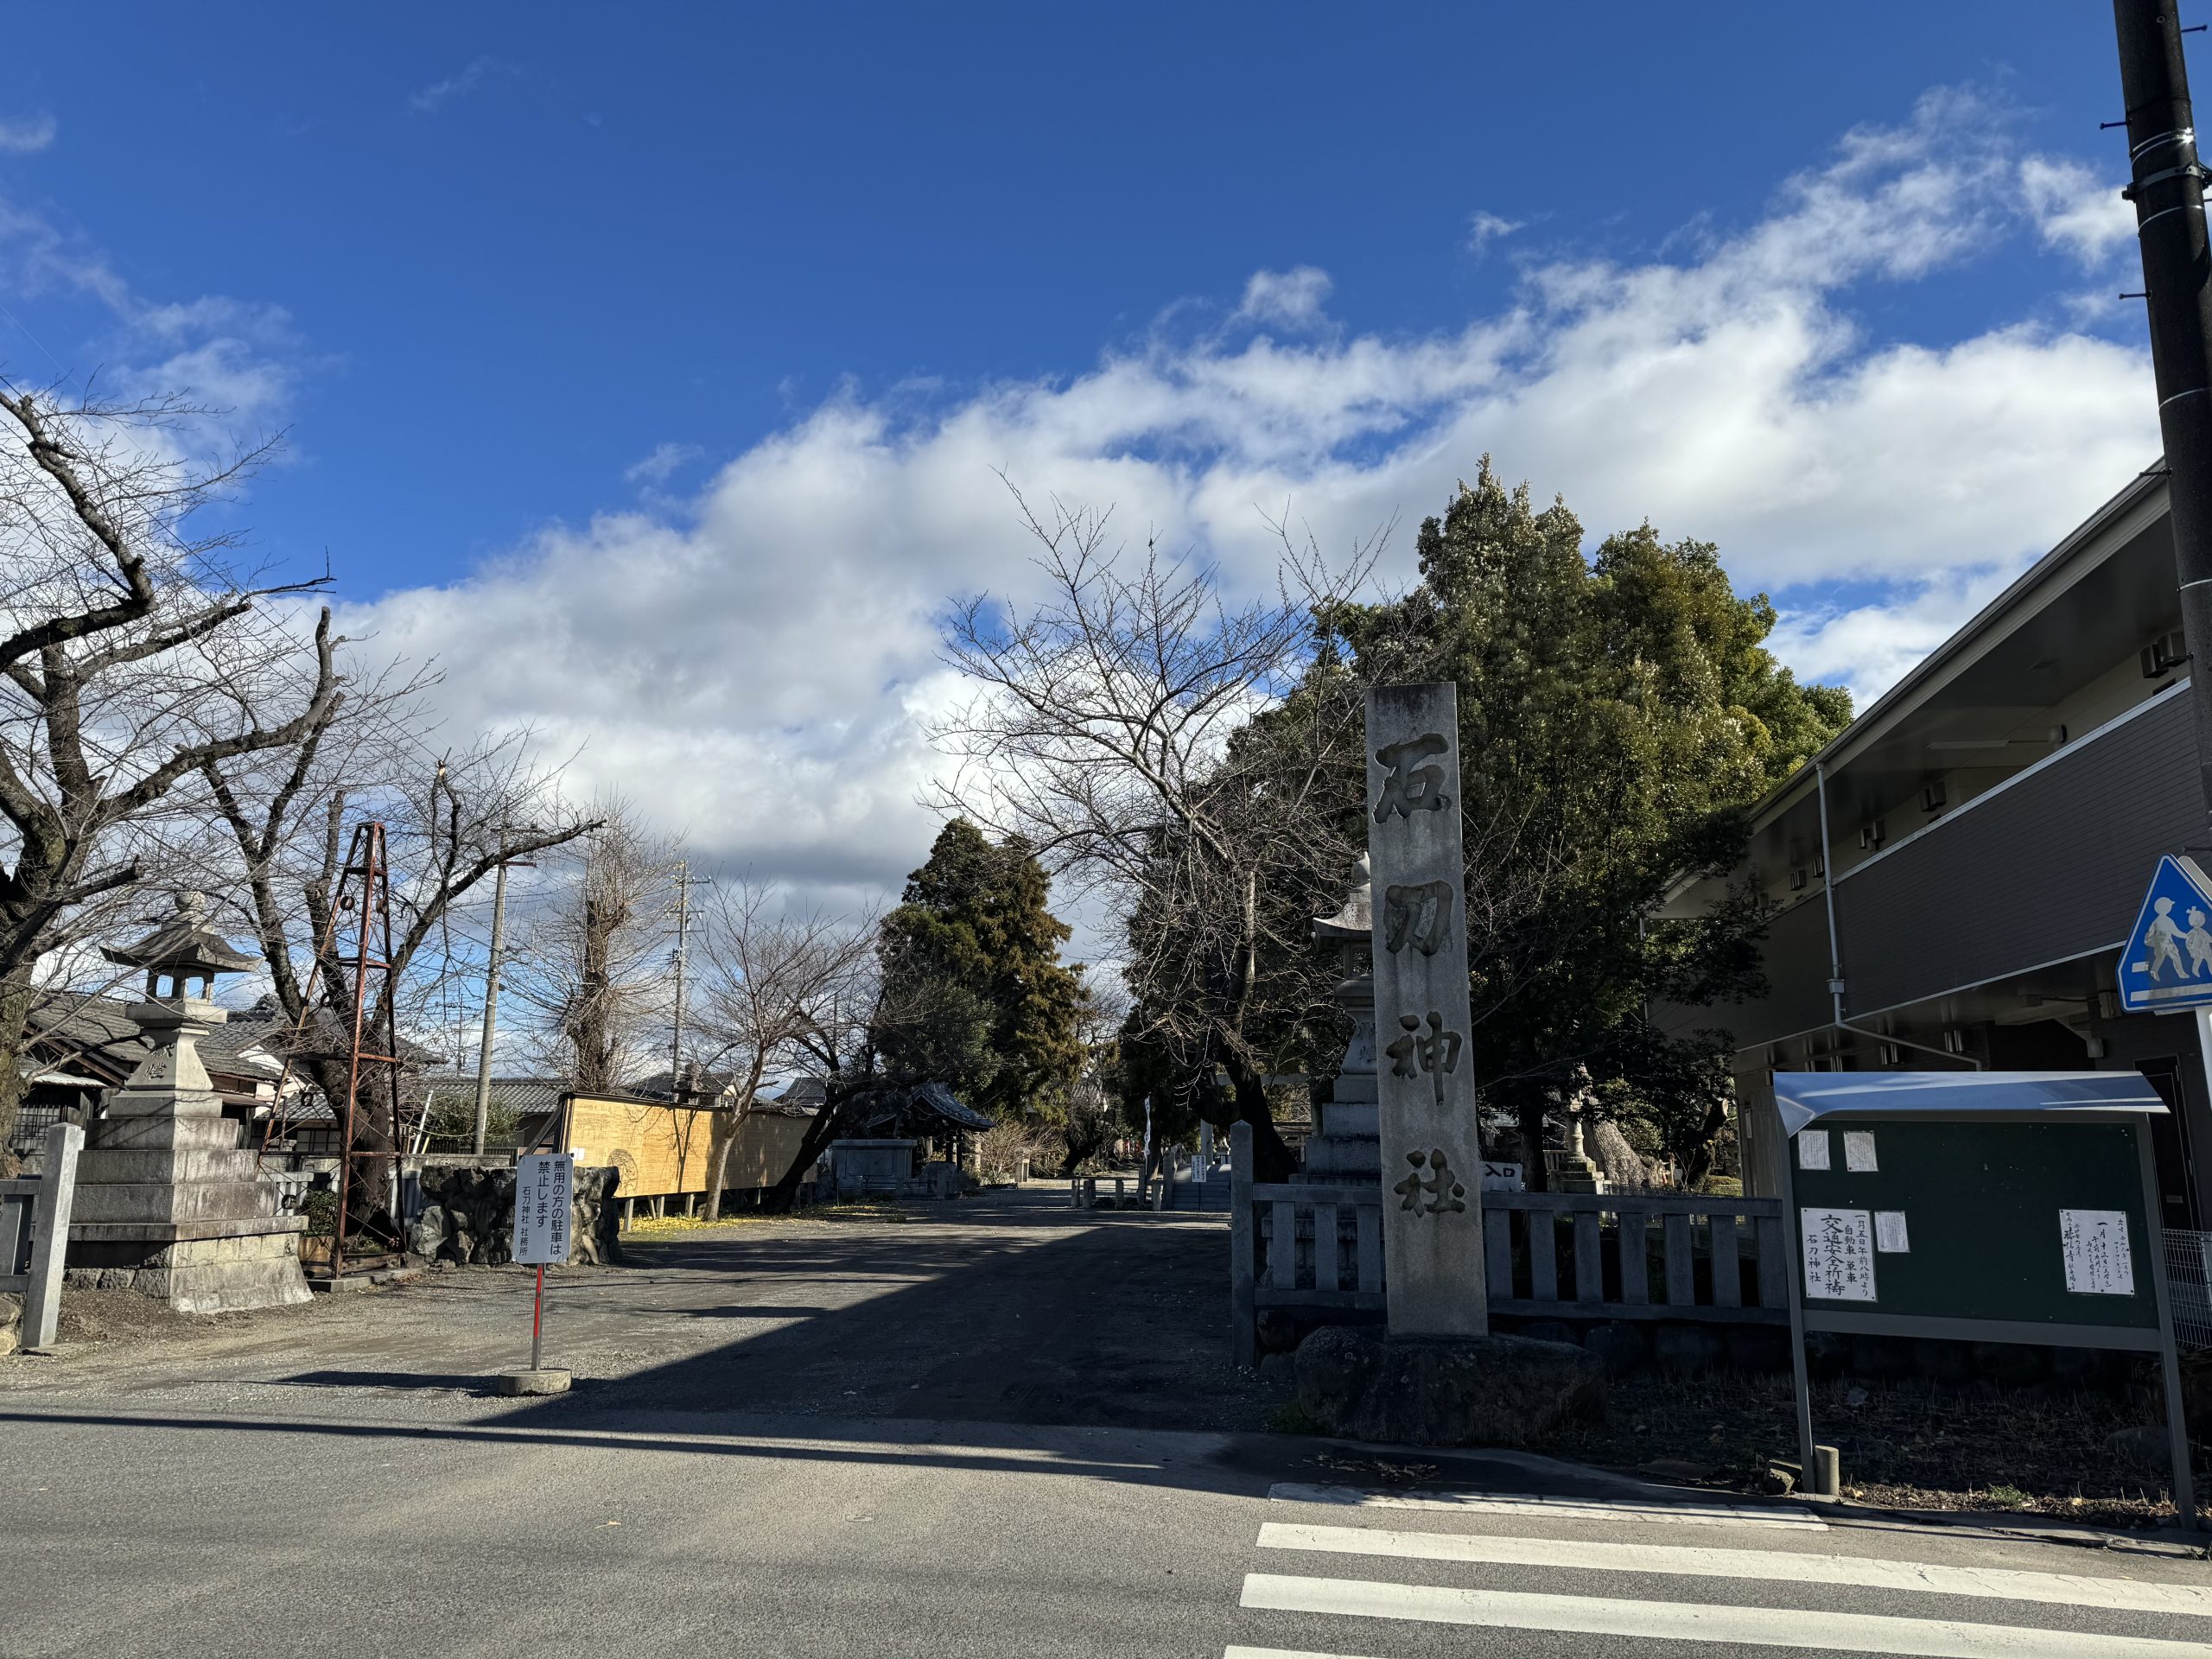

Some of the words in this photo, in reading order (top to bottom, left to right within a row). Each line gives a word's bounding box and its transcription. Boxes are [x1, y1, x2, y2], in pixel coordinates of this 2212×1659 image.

[1372, 733, 1466, 1218] 石刀神社
[537, 1160, 550, 1228] 禁止します
[1485, 1163, 1516, 1178] 入口
[521, 1186, 531, 1224] 石刀神社
[550, 1160, 566, 1255] 無用の方の駐車は
[518, 1227, 529, 1256] 社務所
[1807, 1234, 1821, 1283] 石刀神社
[1854, 1214, 1870, 1297] 一月五日午前八時より
